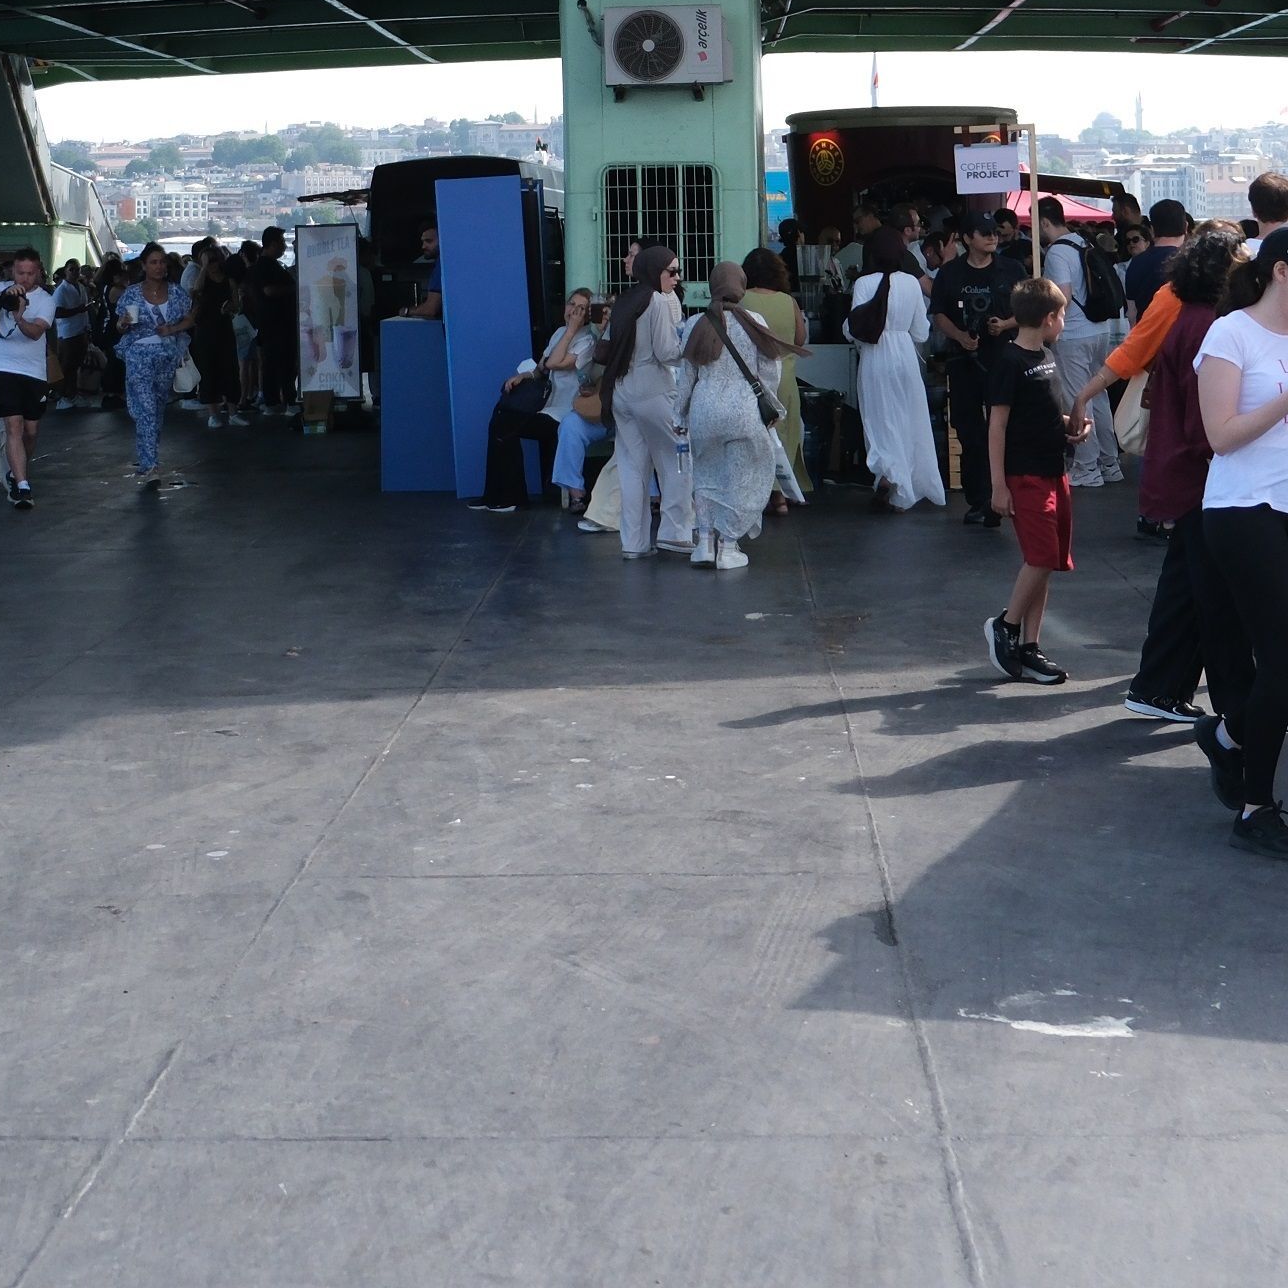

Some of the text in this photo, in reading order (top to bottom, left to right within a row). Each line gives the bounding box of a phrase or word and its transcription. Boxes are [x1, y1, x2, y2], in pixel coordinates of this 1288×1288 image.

[695, 8, 710, 49] arçelik
[960, 162, 998, 172] COFFEE
[966, 170, 1010, 180] PROJECT
